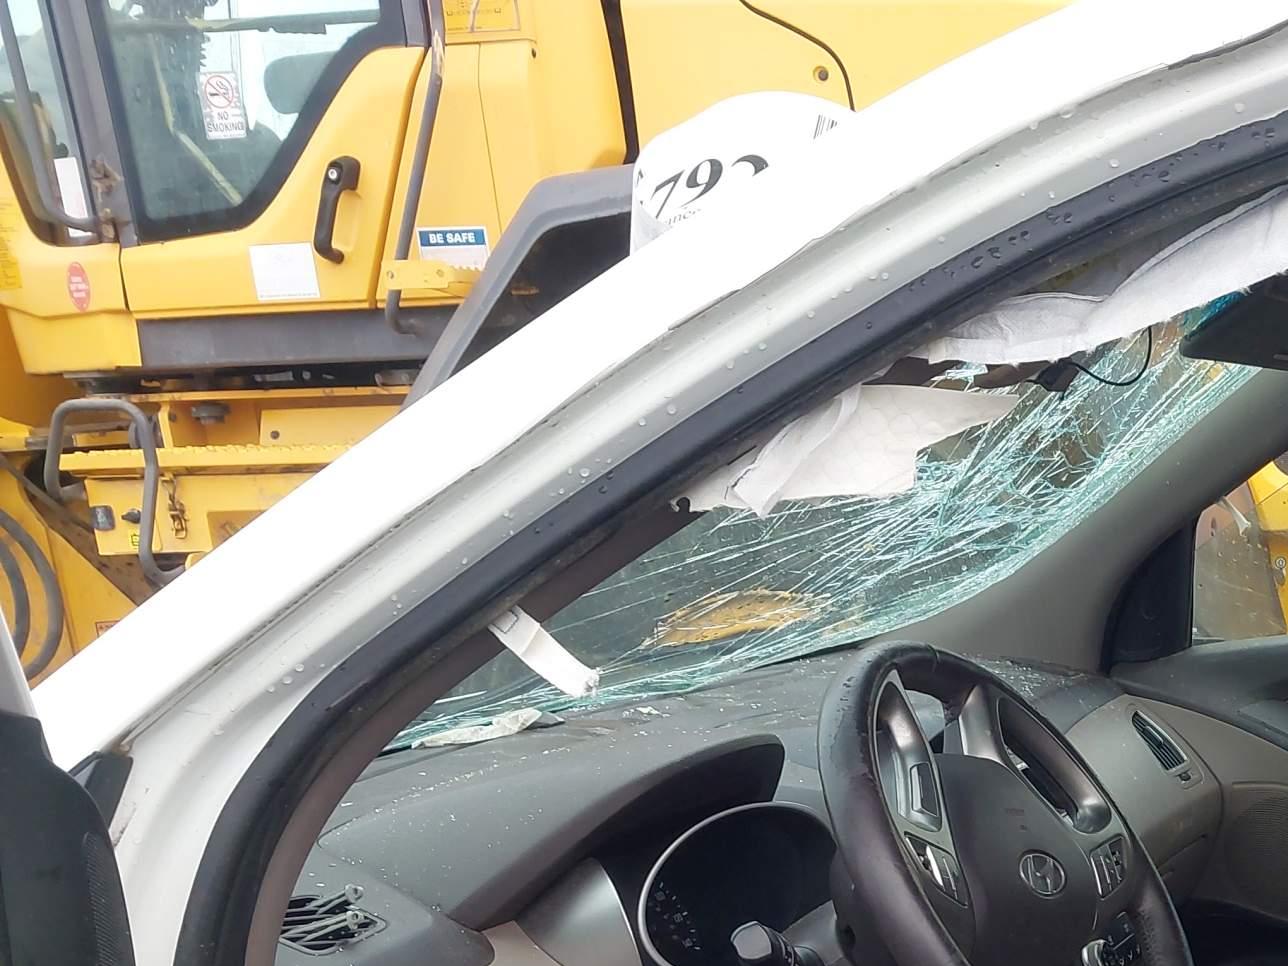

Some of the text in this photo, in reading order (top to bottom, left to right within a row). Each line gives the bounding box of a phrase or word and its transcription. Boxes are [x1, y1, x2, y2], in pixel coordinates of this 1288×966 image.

[217, 111, 229, 120] NO
[207, 121, 245, 133] SMOKING
[428, 232, 476, 244] BE SAFE
